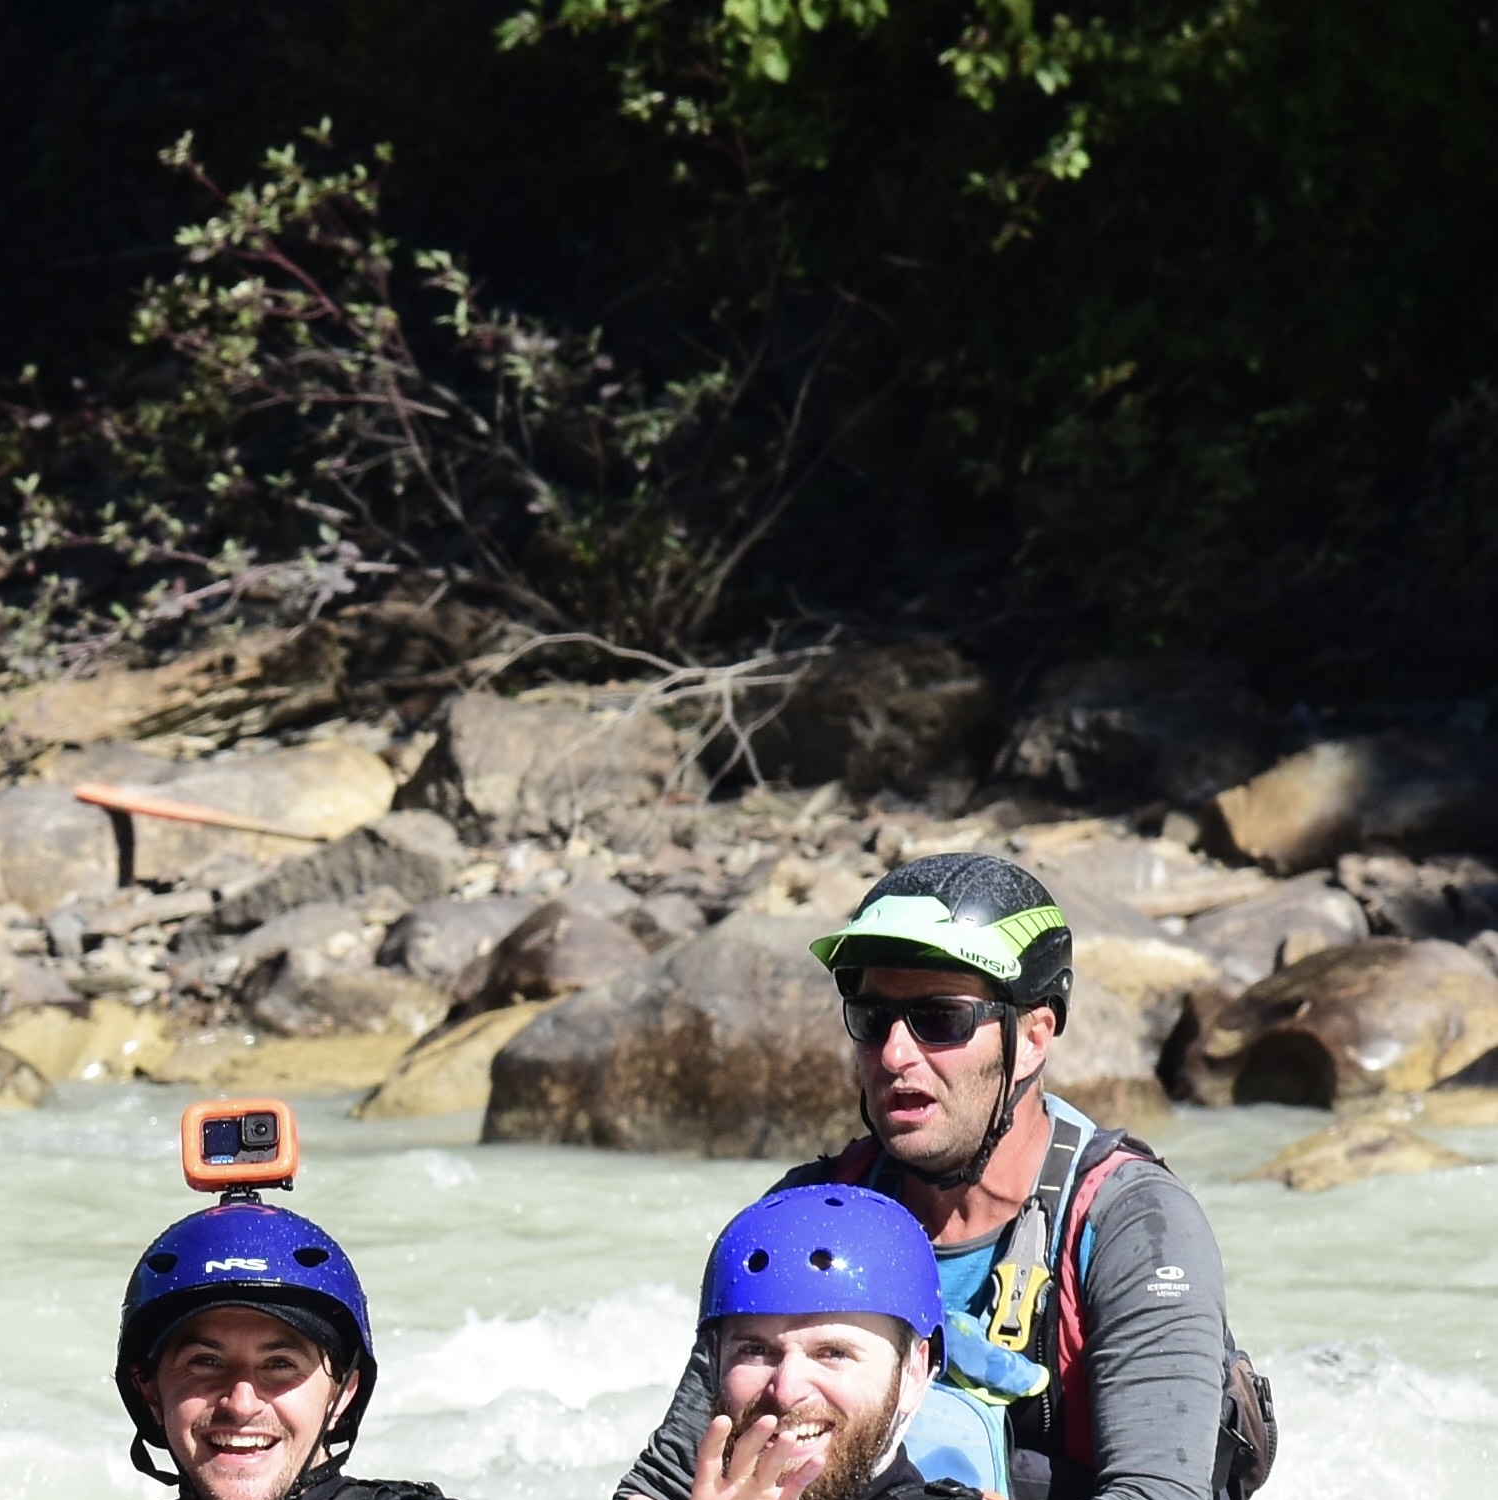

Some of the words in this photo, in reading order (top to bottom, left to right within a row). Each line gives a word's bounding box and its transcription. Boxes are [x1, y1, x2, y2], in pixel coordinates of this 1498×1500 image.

[960, 947, 1006, 975] WRSI
[205, 1257, 268, 1274] NRS
[1147, 1282, 1190, 1291] ICEBREAKER
